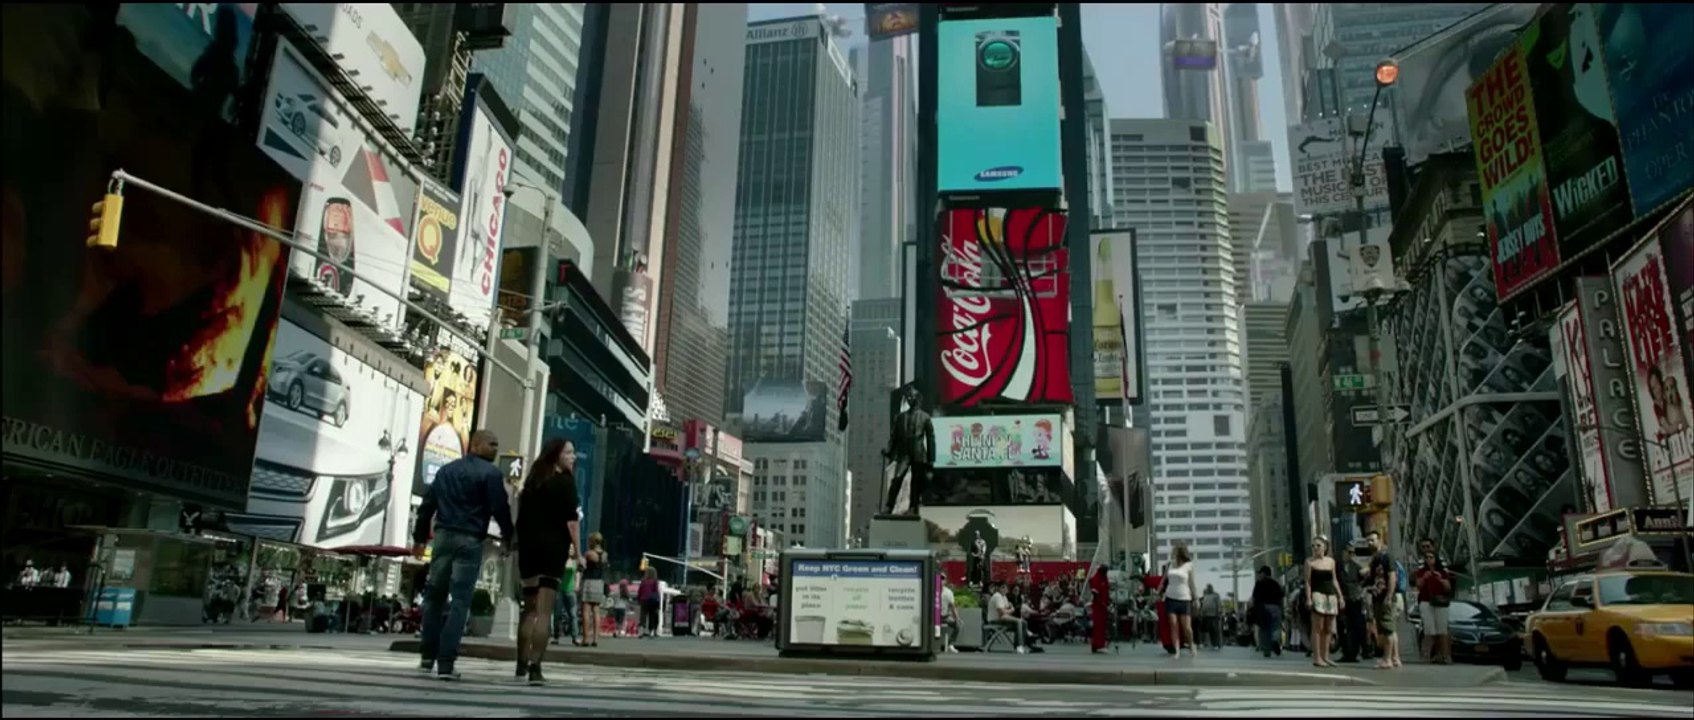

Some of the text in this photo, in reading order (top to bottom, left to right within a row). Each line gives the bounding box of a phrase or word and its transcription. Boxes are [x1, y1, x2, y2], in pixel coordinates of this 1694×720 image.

[746, 27, 788, 41] Allianz
[1471, 49, 1522, 117] THE
[1476, 84, 1525, 138] CROWD
[1480, 105, 1529, 164] GOES
[980, 170, 1018, 178] SAMSUNG
[1301, 170, 1336, 187] THE
[1483, 130, 1535, 190] WILD!
[481, 148, 507, 296] CHICAGO
[1302, 194, 1329, 207] THIS
[418, 216, 442, 266] Q
[1594, 290, 1637, 459] PALACE
[798, 564, 918, 574] Keep NYC Green and Clean!
